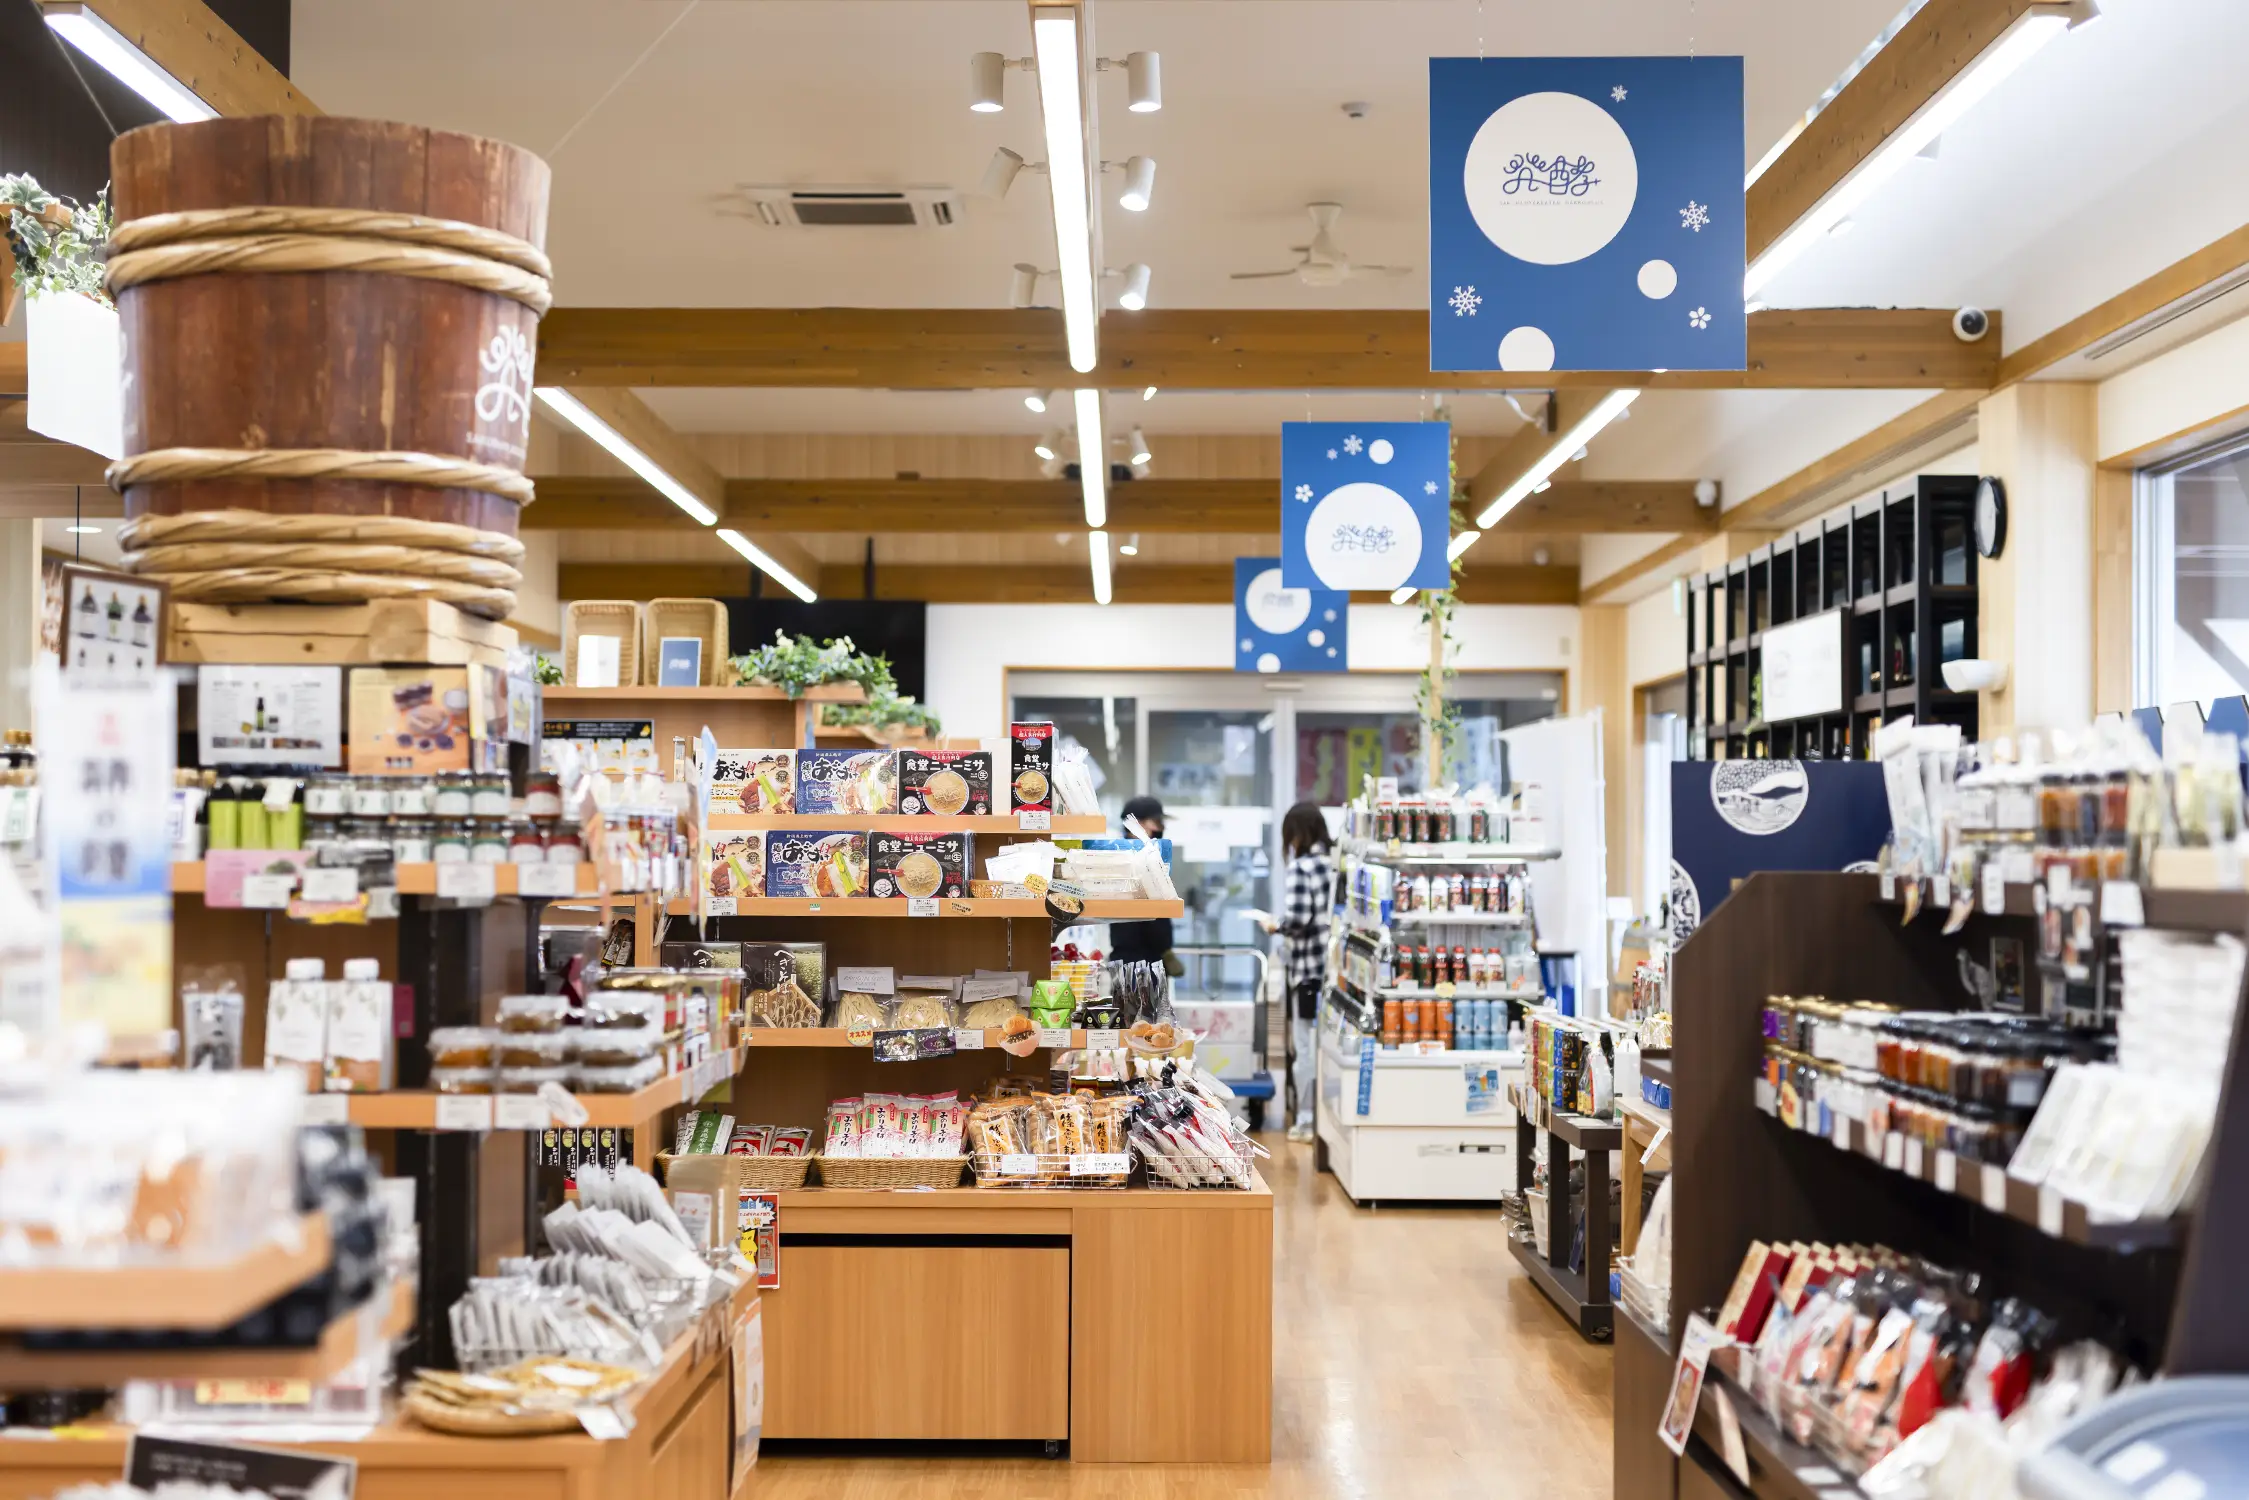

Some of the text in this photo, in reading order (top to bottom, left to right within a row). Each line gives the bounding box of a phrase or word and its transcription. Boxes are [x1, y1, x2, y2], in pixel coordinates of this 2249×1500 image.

[905, 758, 985, 771] 食堂ニューミサ
[1024, 754, 1040, 763] 食堂
[713, 758, 756, 782] あごすけ
[812, 757, 859, 782] あごすけ
[1013, 762, 1050, 771] ニューミサ
[783, 839, 830, 864] あごすけ
[877, 839, 959, 853] 食堂ニューミサ
[773, 949, 796, 994] へぎそば
[848, 1030, 873, 1038] オススメ
